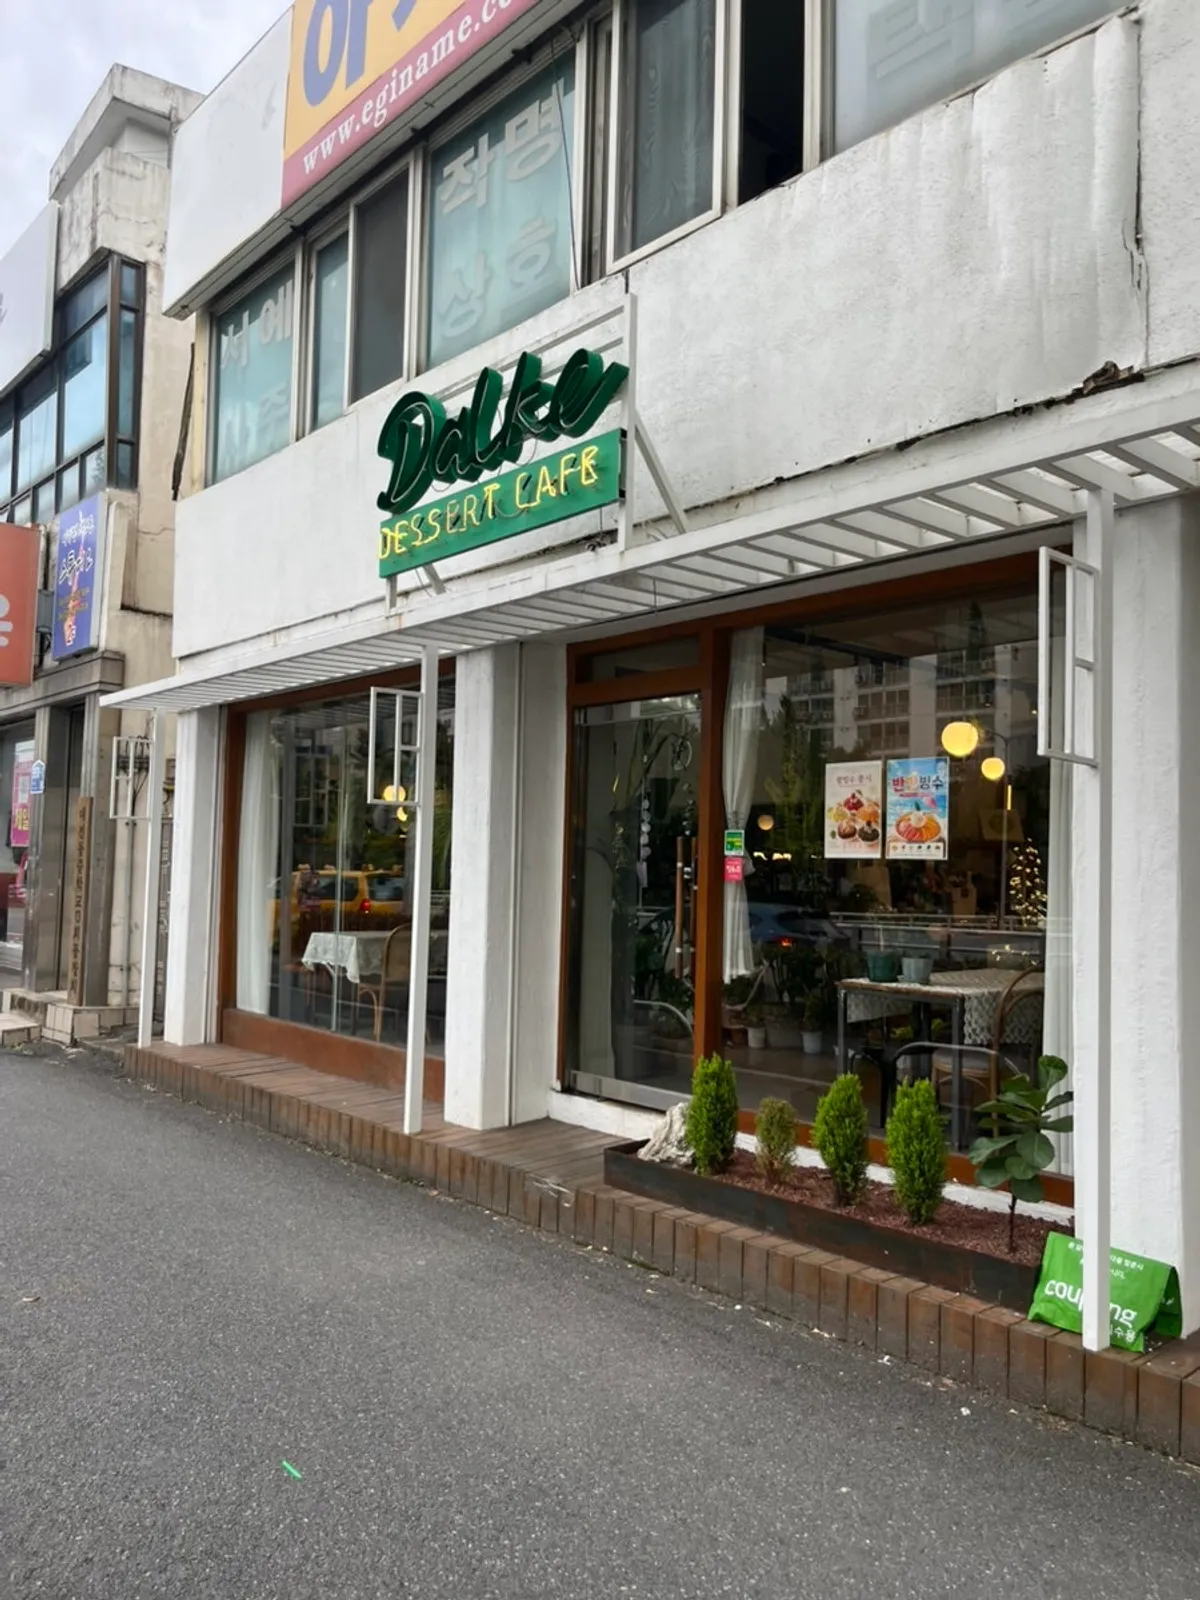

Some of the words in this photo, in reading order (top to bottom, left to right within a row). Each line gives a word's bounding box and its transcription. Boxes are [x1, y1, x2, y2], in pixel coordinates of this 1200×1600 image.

[442, 78, 565, 215] 작명
[221, 280, 293, 370] 서예
[437, 217, 553, 340] 상호
[377, 348, 629, 515] Dalke
[378, 483, 500, 559] DESSERT
[516, 446, 598, 508] CAFE
